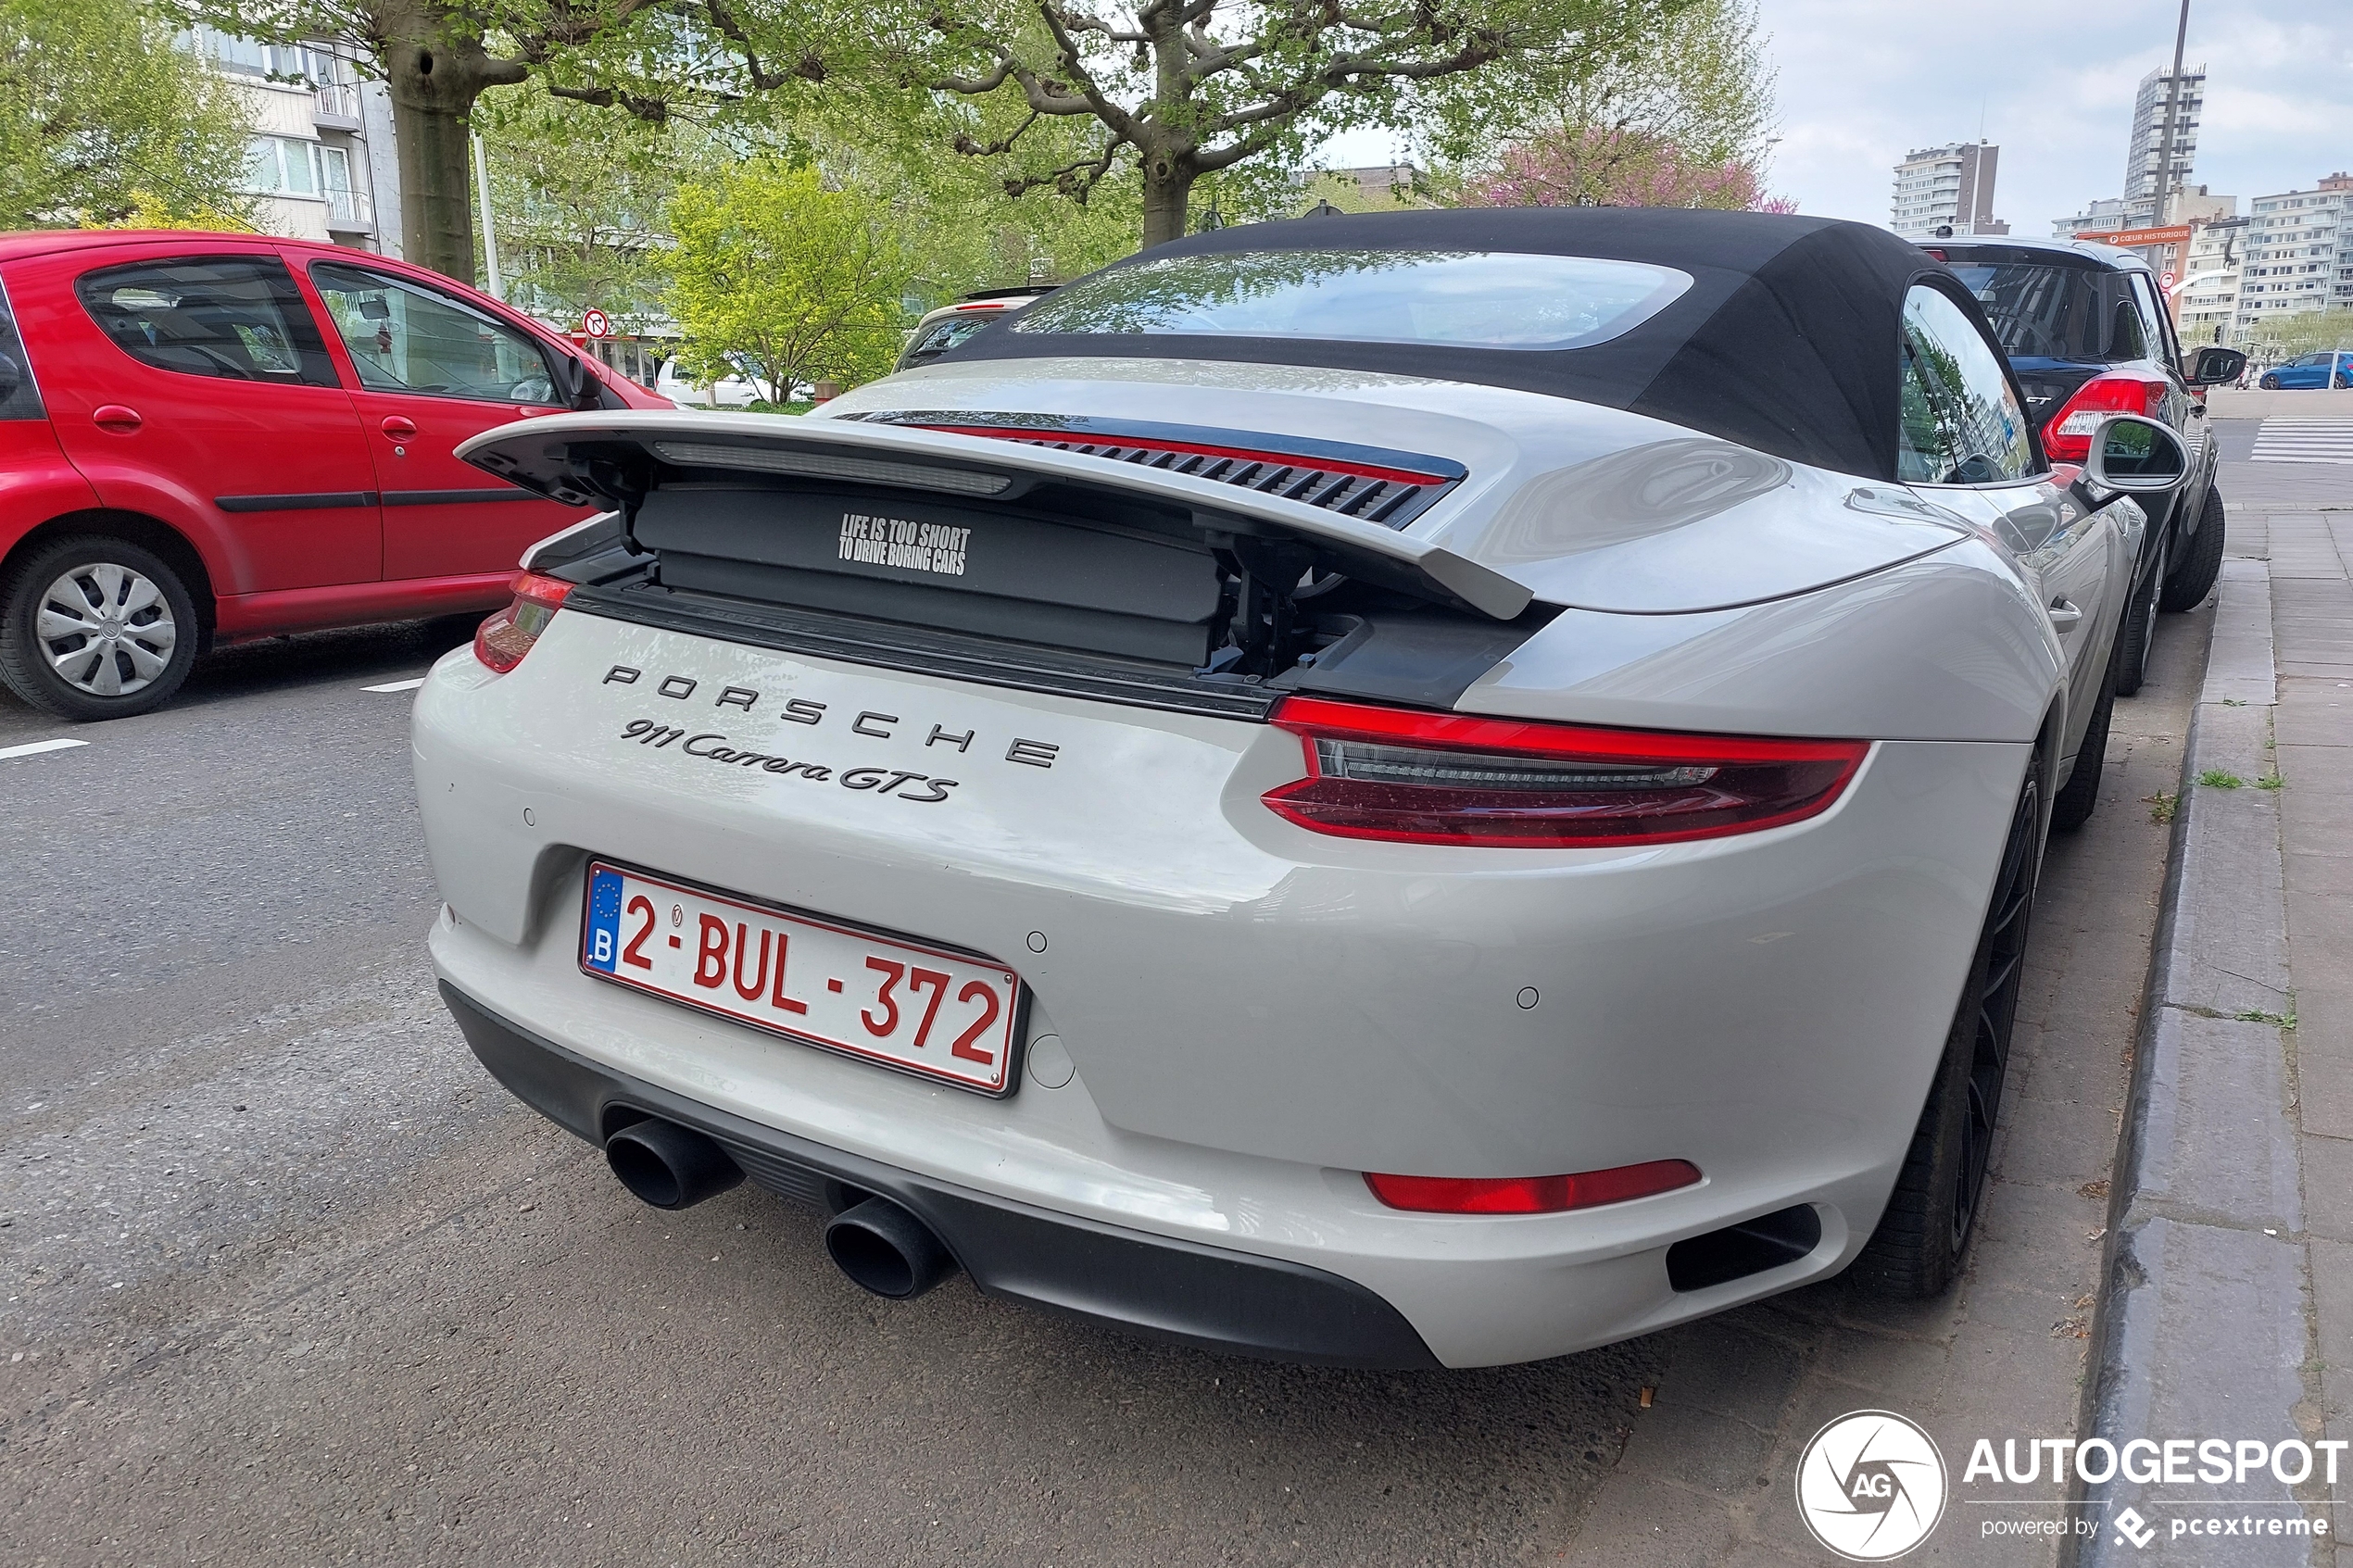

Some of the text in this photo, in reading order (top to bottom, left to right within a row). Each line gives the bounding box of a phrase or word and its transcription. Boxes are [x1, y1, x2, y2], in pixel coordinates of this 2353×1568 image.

[2144, 230, 2190, 240] HISTORIQUE
[840, 513, 972, 552] LIFE IS TOO SHORT
[838, 535, 966, 576] TO DRIVE BORING CARS
[602, 664, 1060, 769] PORSCHE
[620, 718, 960, 803] 911 Carrera GTS
[594, 927, 612, 963] B
